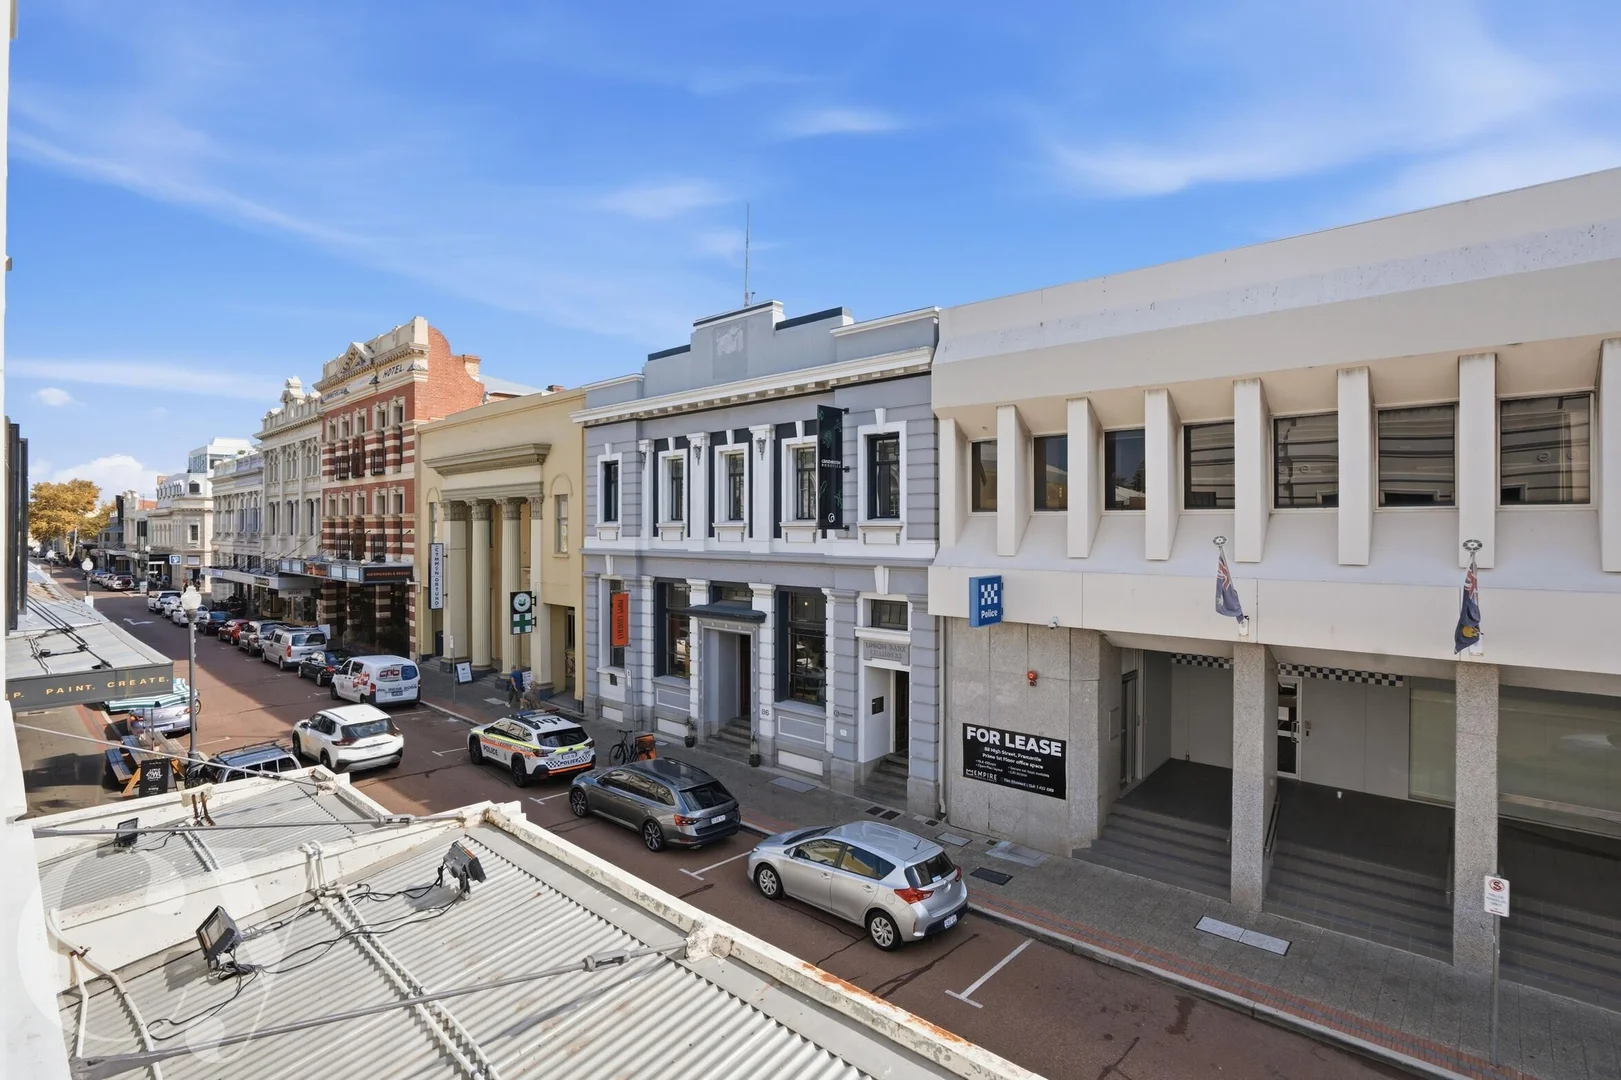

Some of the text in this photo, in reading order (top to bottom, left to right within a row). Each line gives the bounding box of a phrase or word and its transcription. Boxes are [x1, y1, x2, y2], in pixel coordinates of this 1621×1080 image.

[981, 609, 998, 619] Police
[46, 684, 96, 695] PAINT.
[106, 676, 170, 688] CREATE.
[966, 726, 1062, 757] FOR LEASE
[483, 744, 498, 756] POLICE
[560, 758, 578, 766] POLICE
[1018, 753, 1042, 762] Fremantle
[1030, 762, 1044, 770] space
[974, 770, 997, 780] EMPIRE
